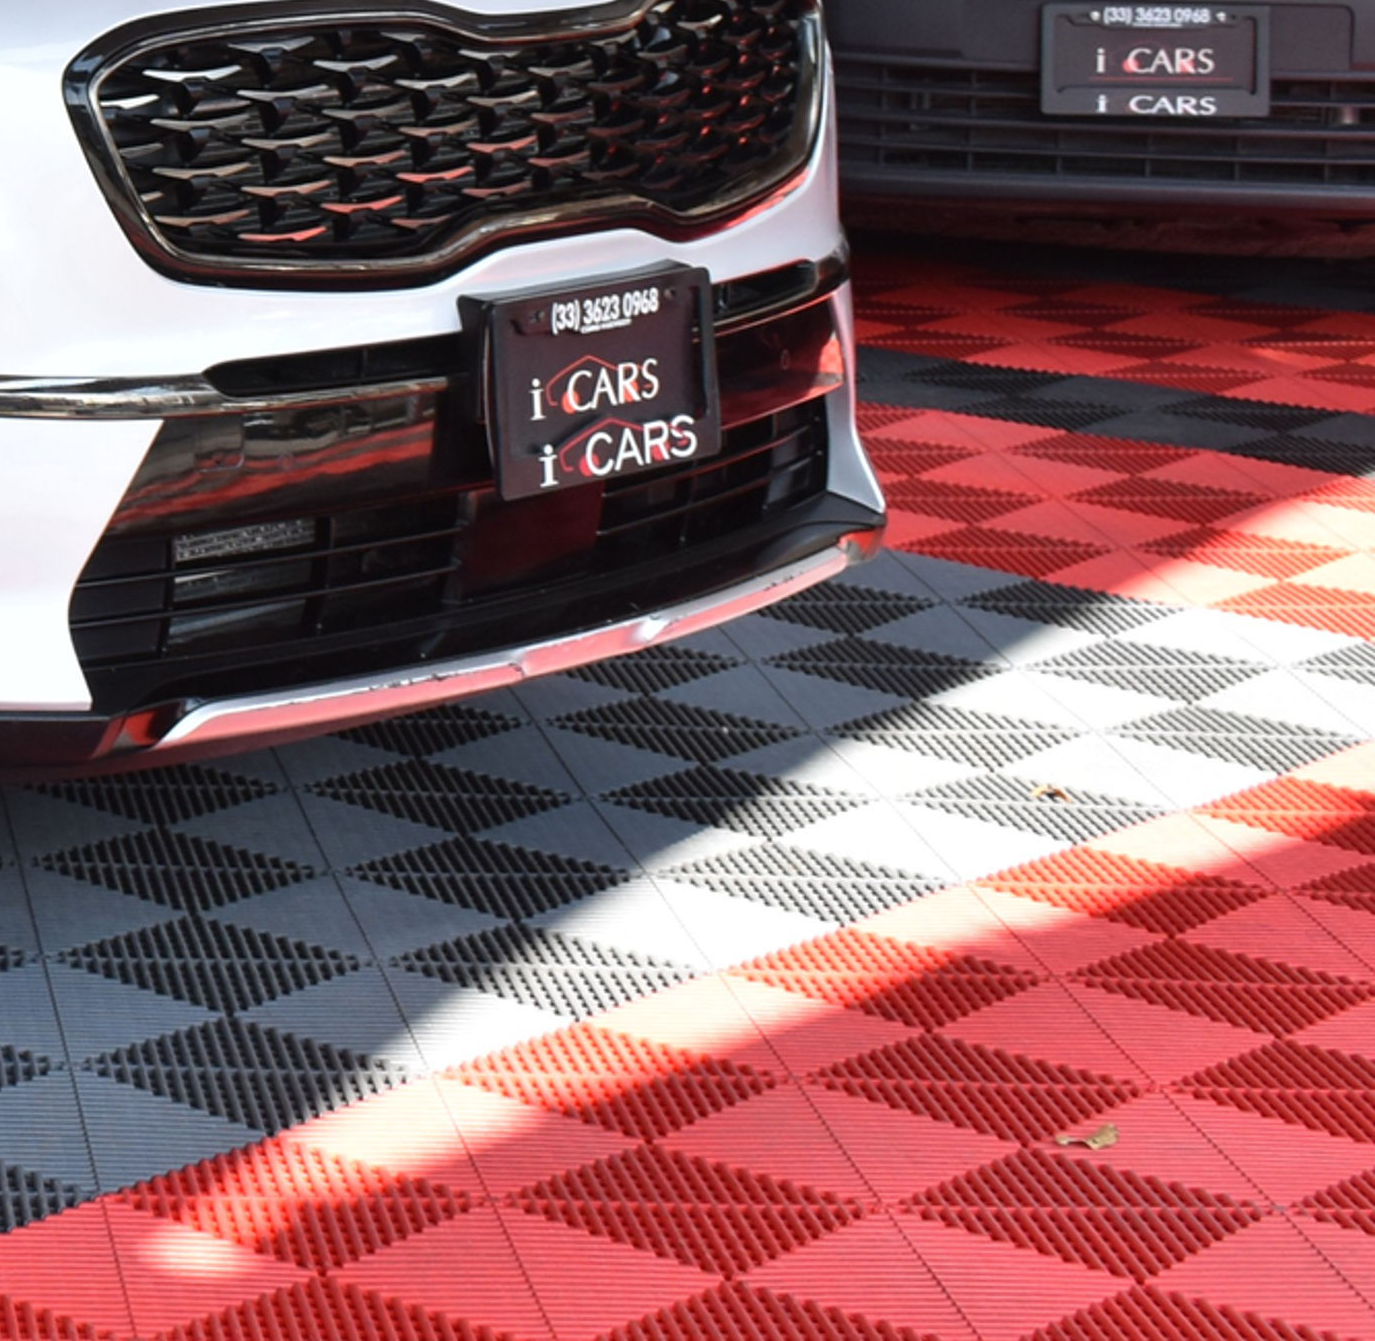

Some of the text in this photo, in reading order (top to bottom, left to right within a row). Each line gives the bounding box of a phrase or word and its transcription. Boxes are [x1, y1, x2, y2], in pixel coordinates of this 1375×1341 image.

[1103, 7, 1211, 25] (33) 3623 0968
[1096, 48, 1215, 74] i CARS
[1096, 94, 1217, 115] i CARS
[552, 299, 581, 335] (33)
[582, 294, 620, 324] 3623
[622, 287, 659, 317] 0968
[530, 358, 660, 421] i CARS
[539, 414, 698, 488] i CARS
